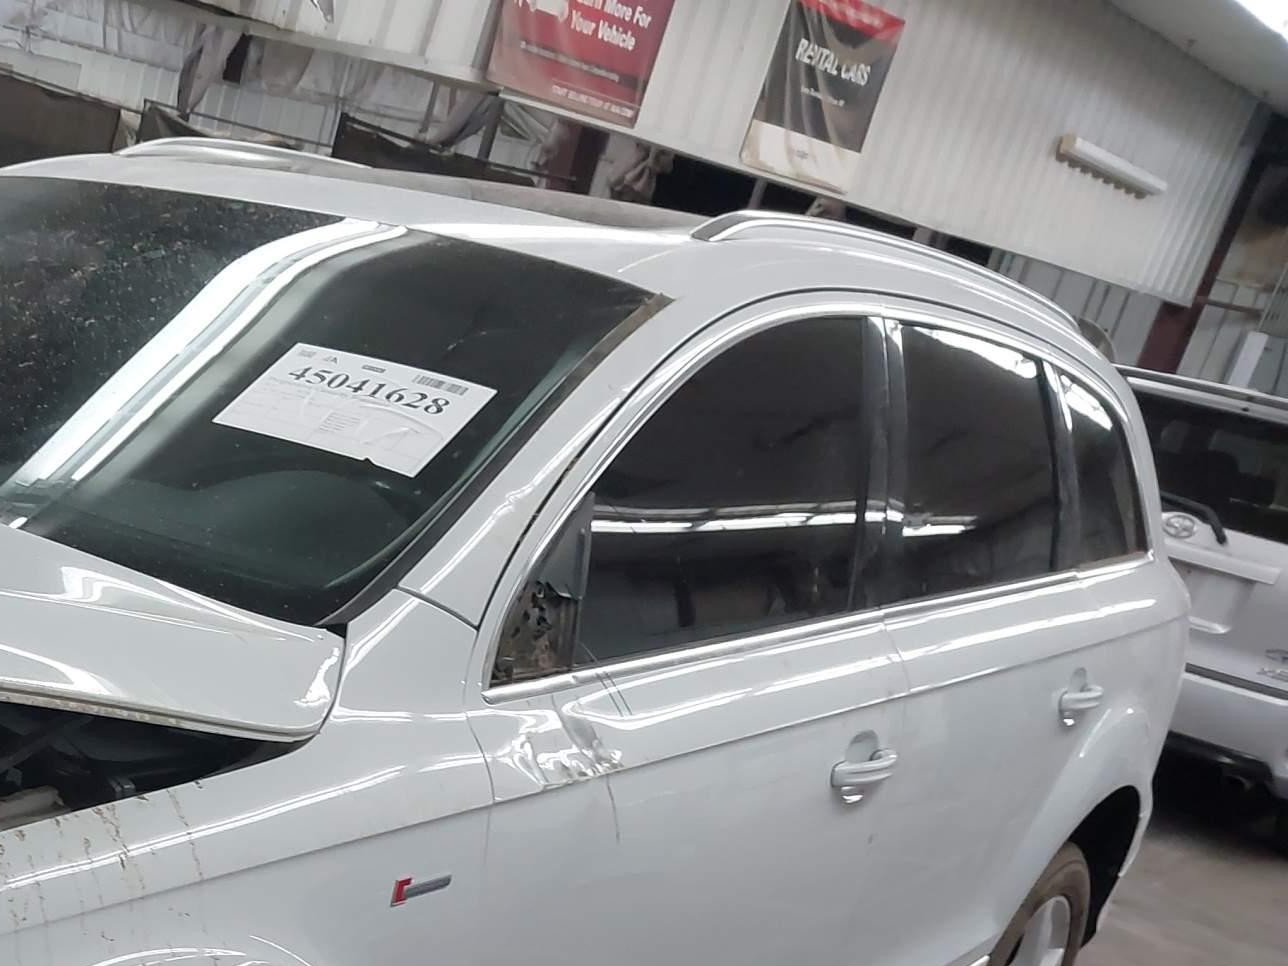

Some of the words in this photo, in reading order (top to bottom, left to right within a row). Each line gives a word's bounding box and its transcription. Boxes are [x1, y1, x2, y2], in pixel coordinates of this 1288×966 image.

[571, 9, 596, 36] Your
[598, 20, 636, 51] Vehicle
[603, 0, 633, 22] More
[633, 5, 652, 29] For
[795, 38, 838, 75] RENTAL
[840, 63, 871, 86] CARS
[289, 366, 450, 415] 45041628
